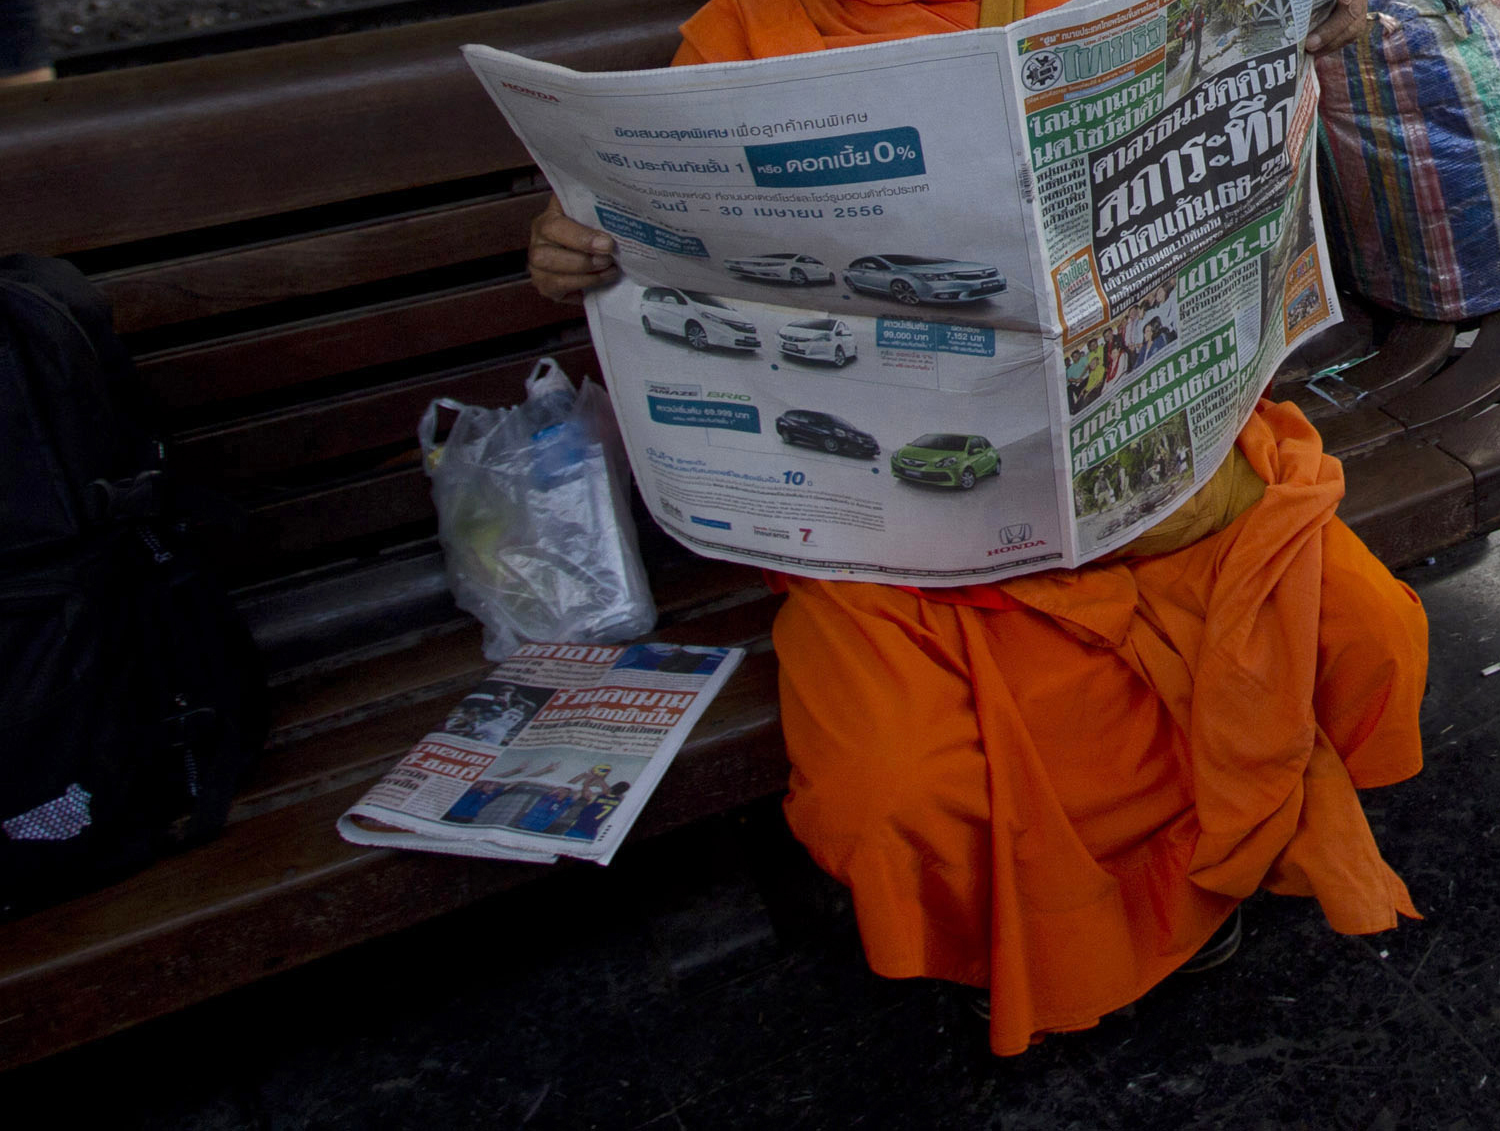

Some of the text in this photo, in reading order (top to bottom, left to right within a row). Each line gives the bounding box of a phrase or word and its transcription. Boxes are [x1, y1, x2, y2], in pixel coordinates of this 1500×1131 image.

[501, 81, 560, 103] HONDA
[614, 111, 868, 142] ข้อเสนอสุดพิเศษ เพื่อลูกค้าคนพิเศษ
[757, 140, 916, 174] หรือ ดอกเบี้ย 0%
[634, 159, 730, 174] ประกันภัยชั้น
[650, 199, 688, 213] วันนี้
[720, 206, 743, 217] 30
[753, 206, 823, 219] เมษายน
[833, 204, 885, 218] 2556
[648, 388, 751, 401] AMAZE BRIO
[782, 470, 806, 486] 10
[799, 527, 812, 542] 7
[986, 539, 1048, 557] HONDA
